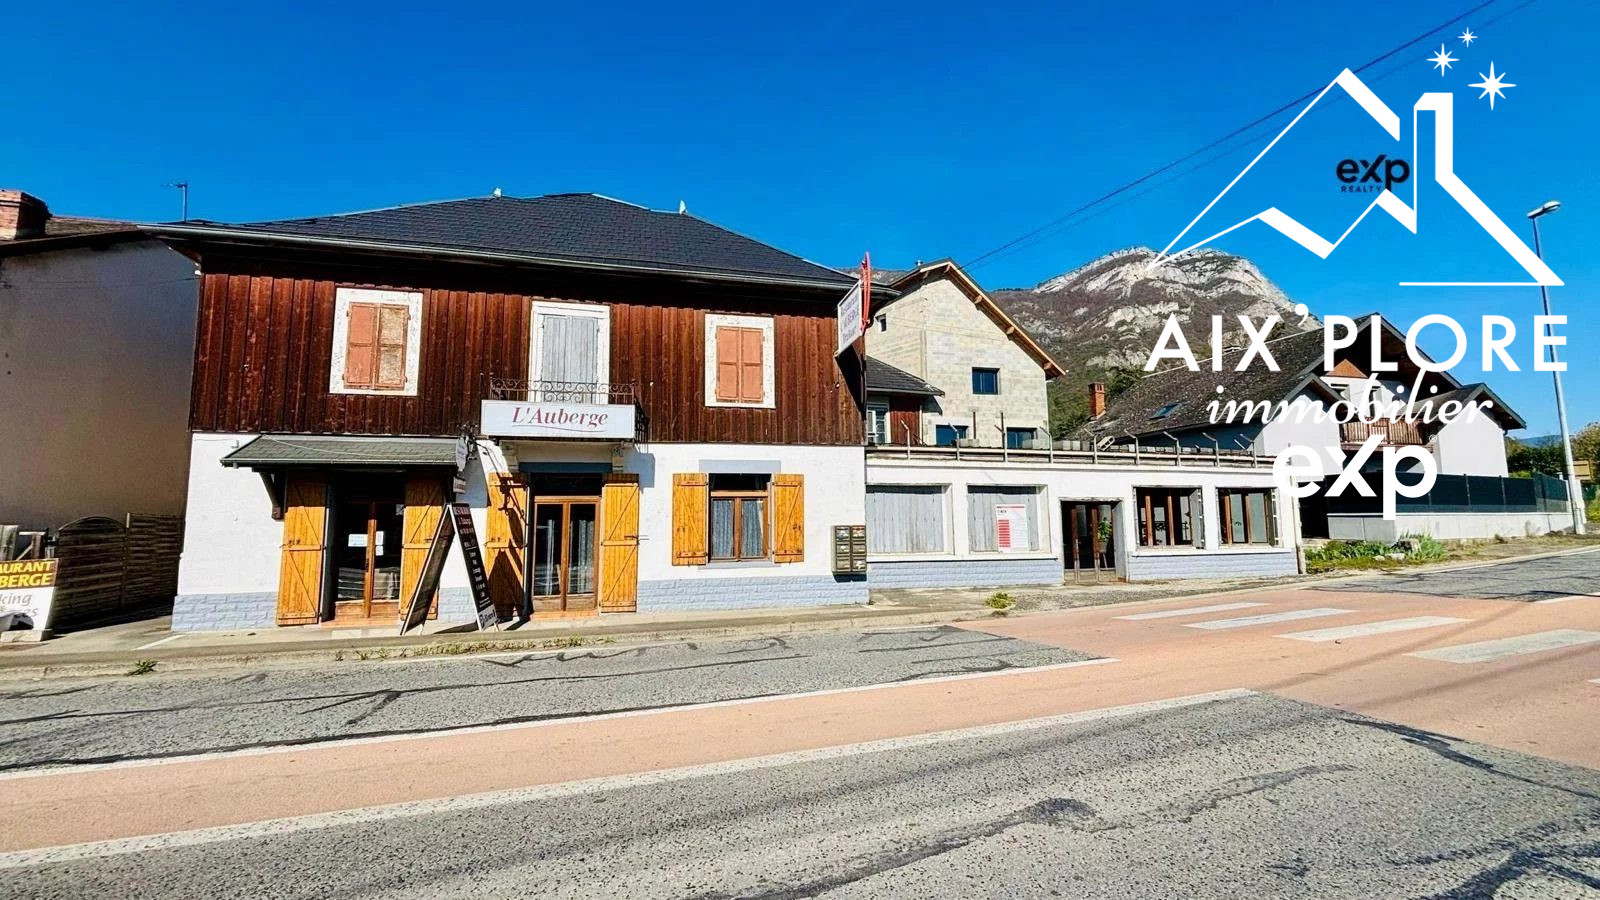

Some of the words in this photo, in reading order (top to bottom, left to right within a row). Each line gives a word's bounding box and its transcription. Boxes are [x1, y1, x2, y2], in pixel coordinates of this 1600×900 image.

[511, 406, 609, 428] L'Auberge
[0, 561, 54, 573] URANT
[0, 573, 52, 587] BERGE
